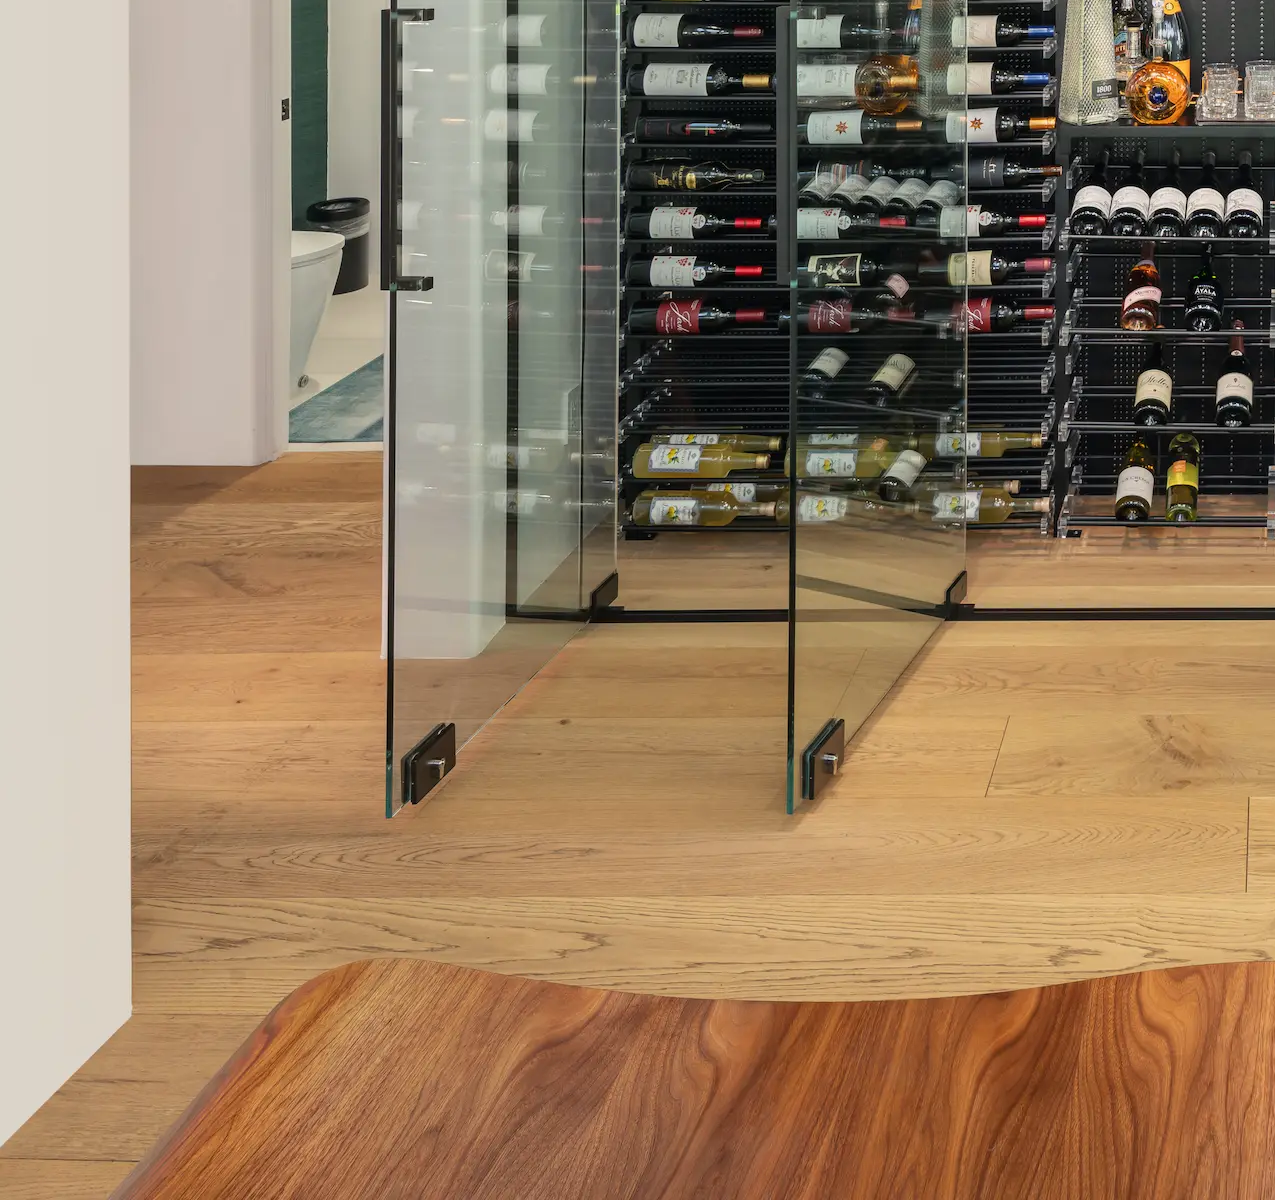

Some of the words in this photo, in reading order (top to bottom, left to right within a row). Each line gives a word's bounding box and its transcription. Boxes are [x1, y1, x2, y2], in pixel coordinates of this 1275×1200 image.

[1096, 85, 1112, 93] 1800
[1194, 287, 1216, 296] AYALA
[669, 302, 692, 333] Josh
[824, 302, 844, 328] Josh
[967, 304, 984, 331] Josh
